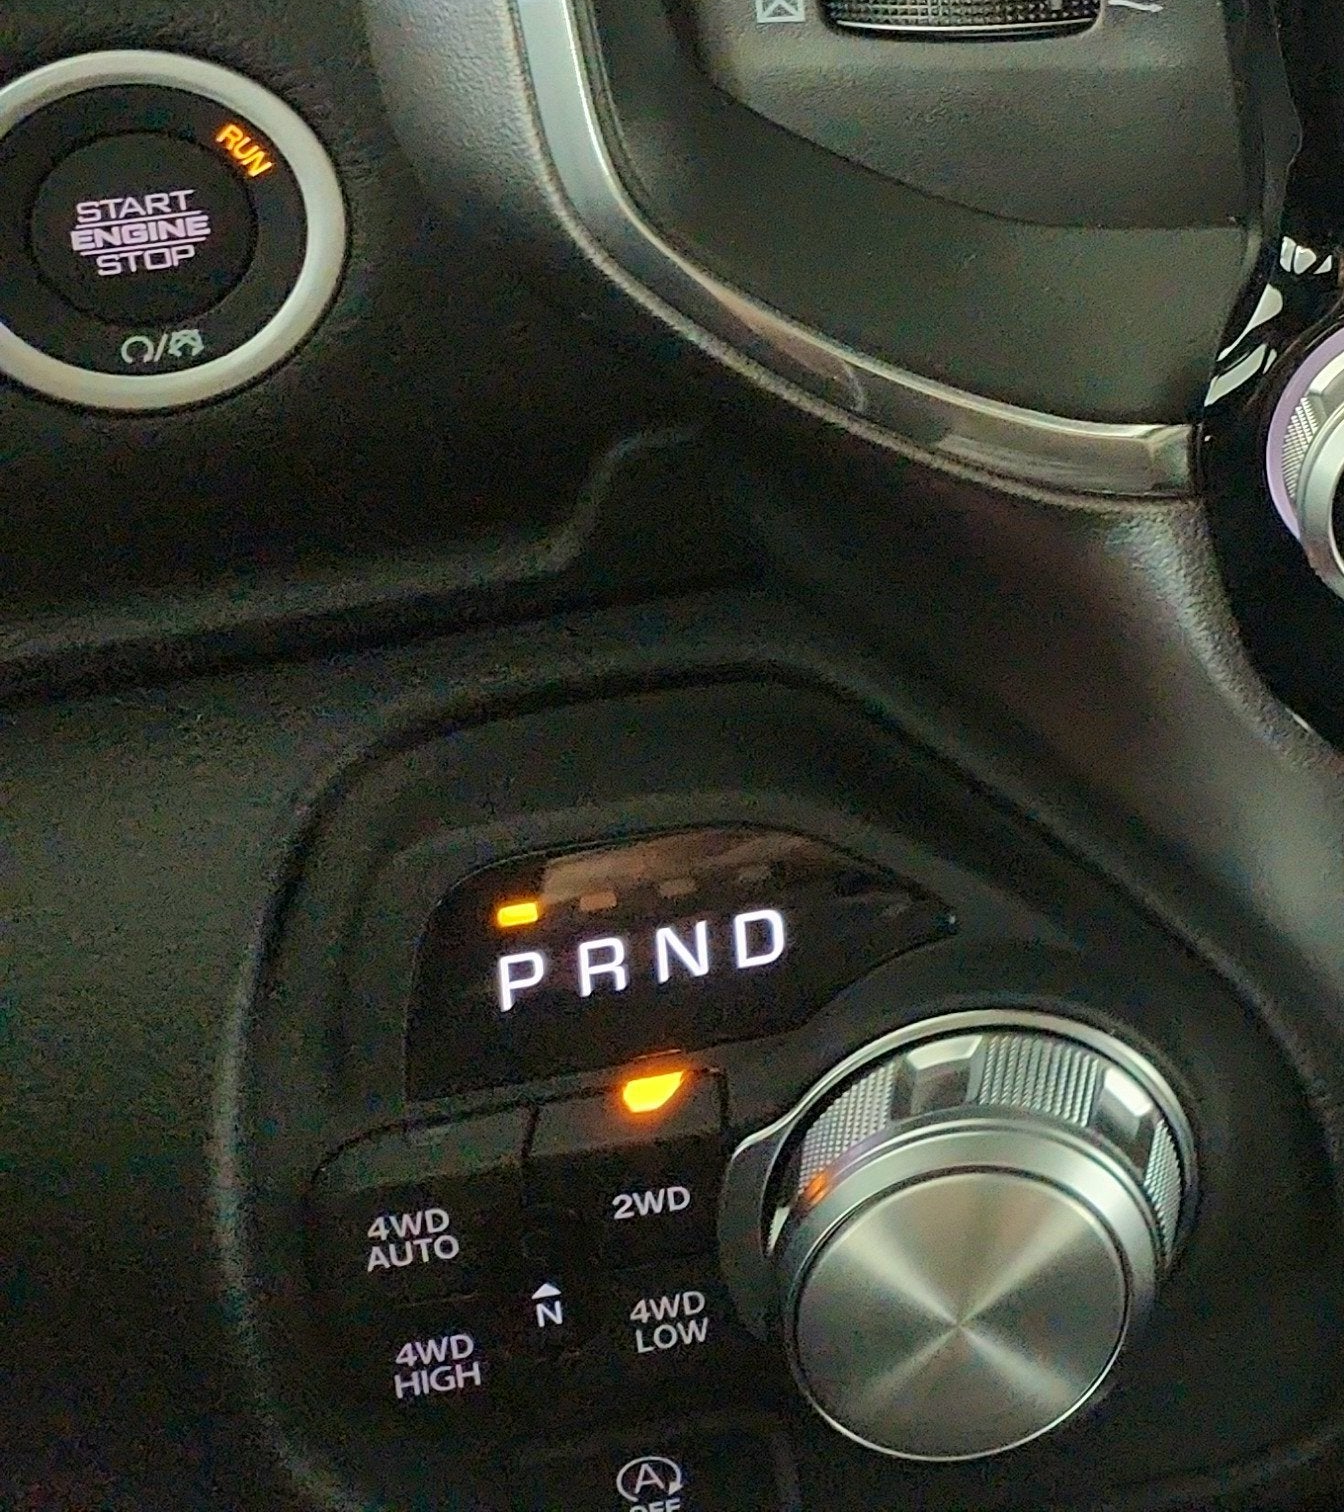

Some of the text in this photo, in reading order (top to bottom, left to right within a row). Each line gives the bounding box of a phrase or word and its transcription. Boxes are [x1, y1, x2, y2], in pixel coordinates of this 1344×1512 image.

[216, 124, 273, 178] RUN
[76, 189, 197, 223] START
[70, 214, 211, 252] ENGINE
[97, 244, 196, 276] STOP
[612, 1186, 691, 1220] 2WD
[367, 1207, 451, 1242] 4WD
[366, 1234, 460, 1271] AUTO
[535, 1301, 563, 1327] N
[629, 1290, 706, 1324] 4WD
[395, 1333, 475, 1366] 4WD
[635, 1317, 710, 1354] LOW
[394, 1361, 482, 1399] HIGH
